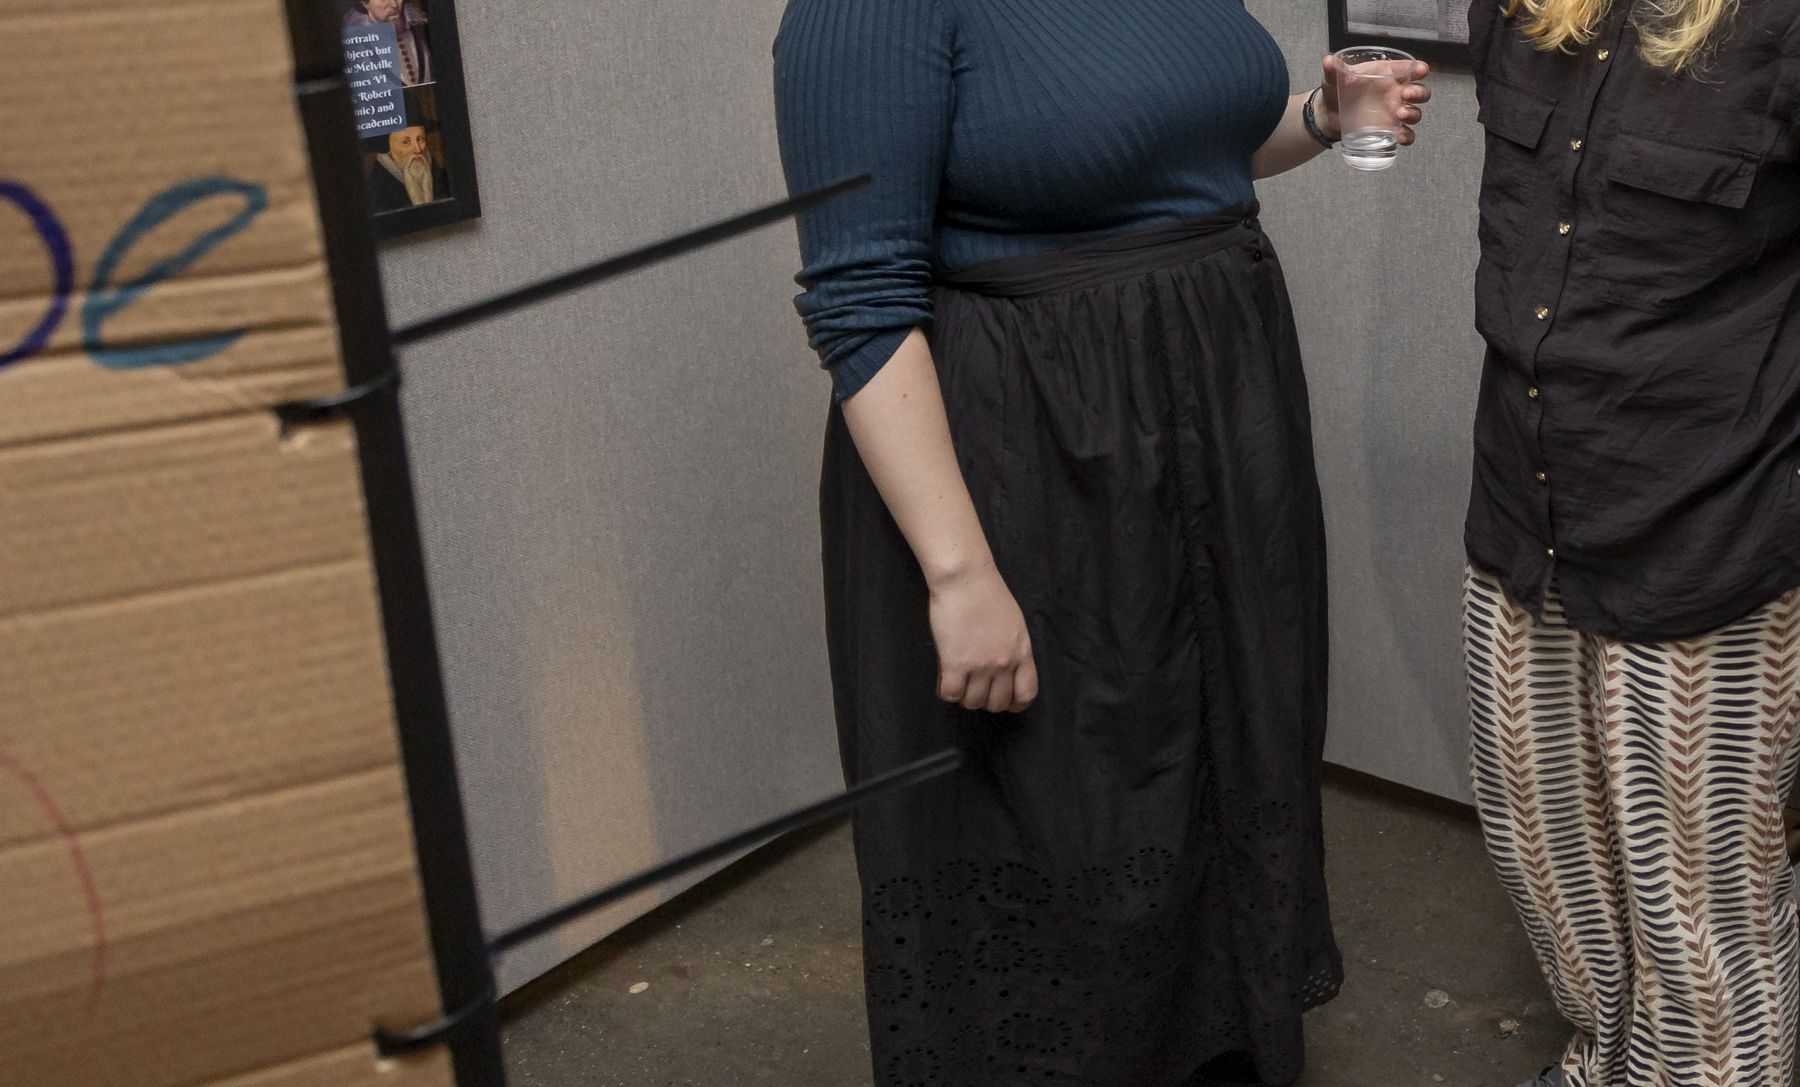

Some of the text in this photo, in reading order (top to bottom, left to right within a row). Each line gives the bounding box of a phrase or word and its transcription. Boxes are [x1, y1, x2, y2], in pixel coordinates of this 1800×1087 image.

[344, 34, 380, 45] ortraits
[346, 46, 392, 61] bjects but
[354, 59, 393, 73] Melville
[373, 74, 387, 84] VI
[358, 89, 392, 101] Robert
[377, 102, 394, 113] and
